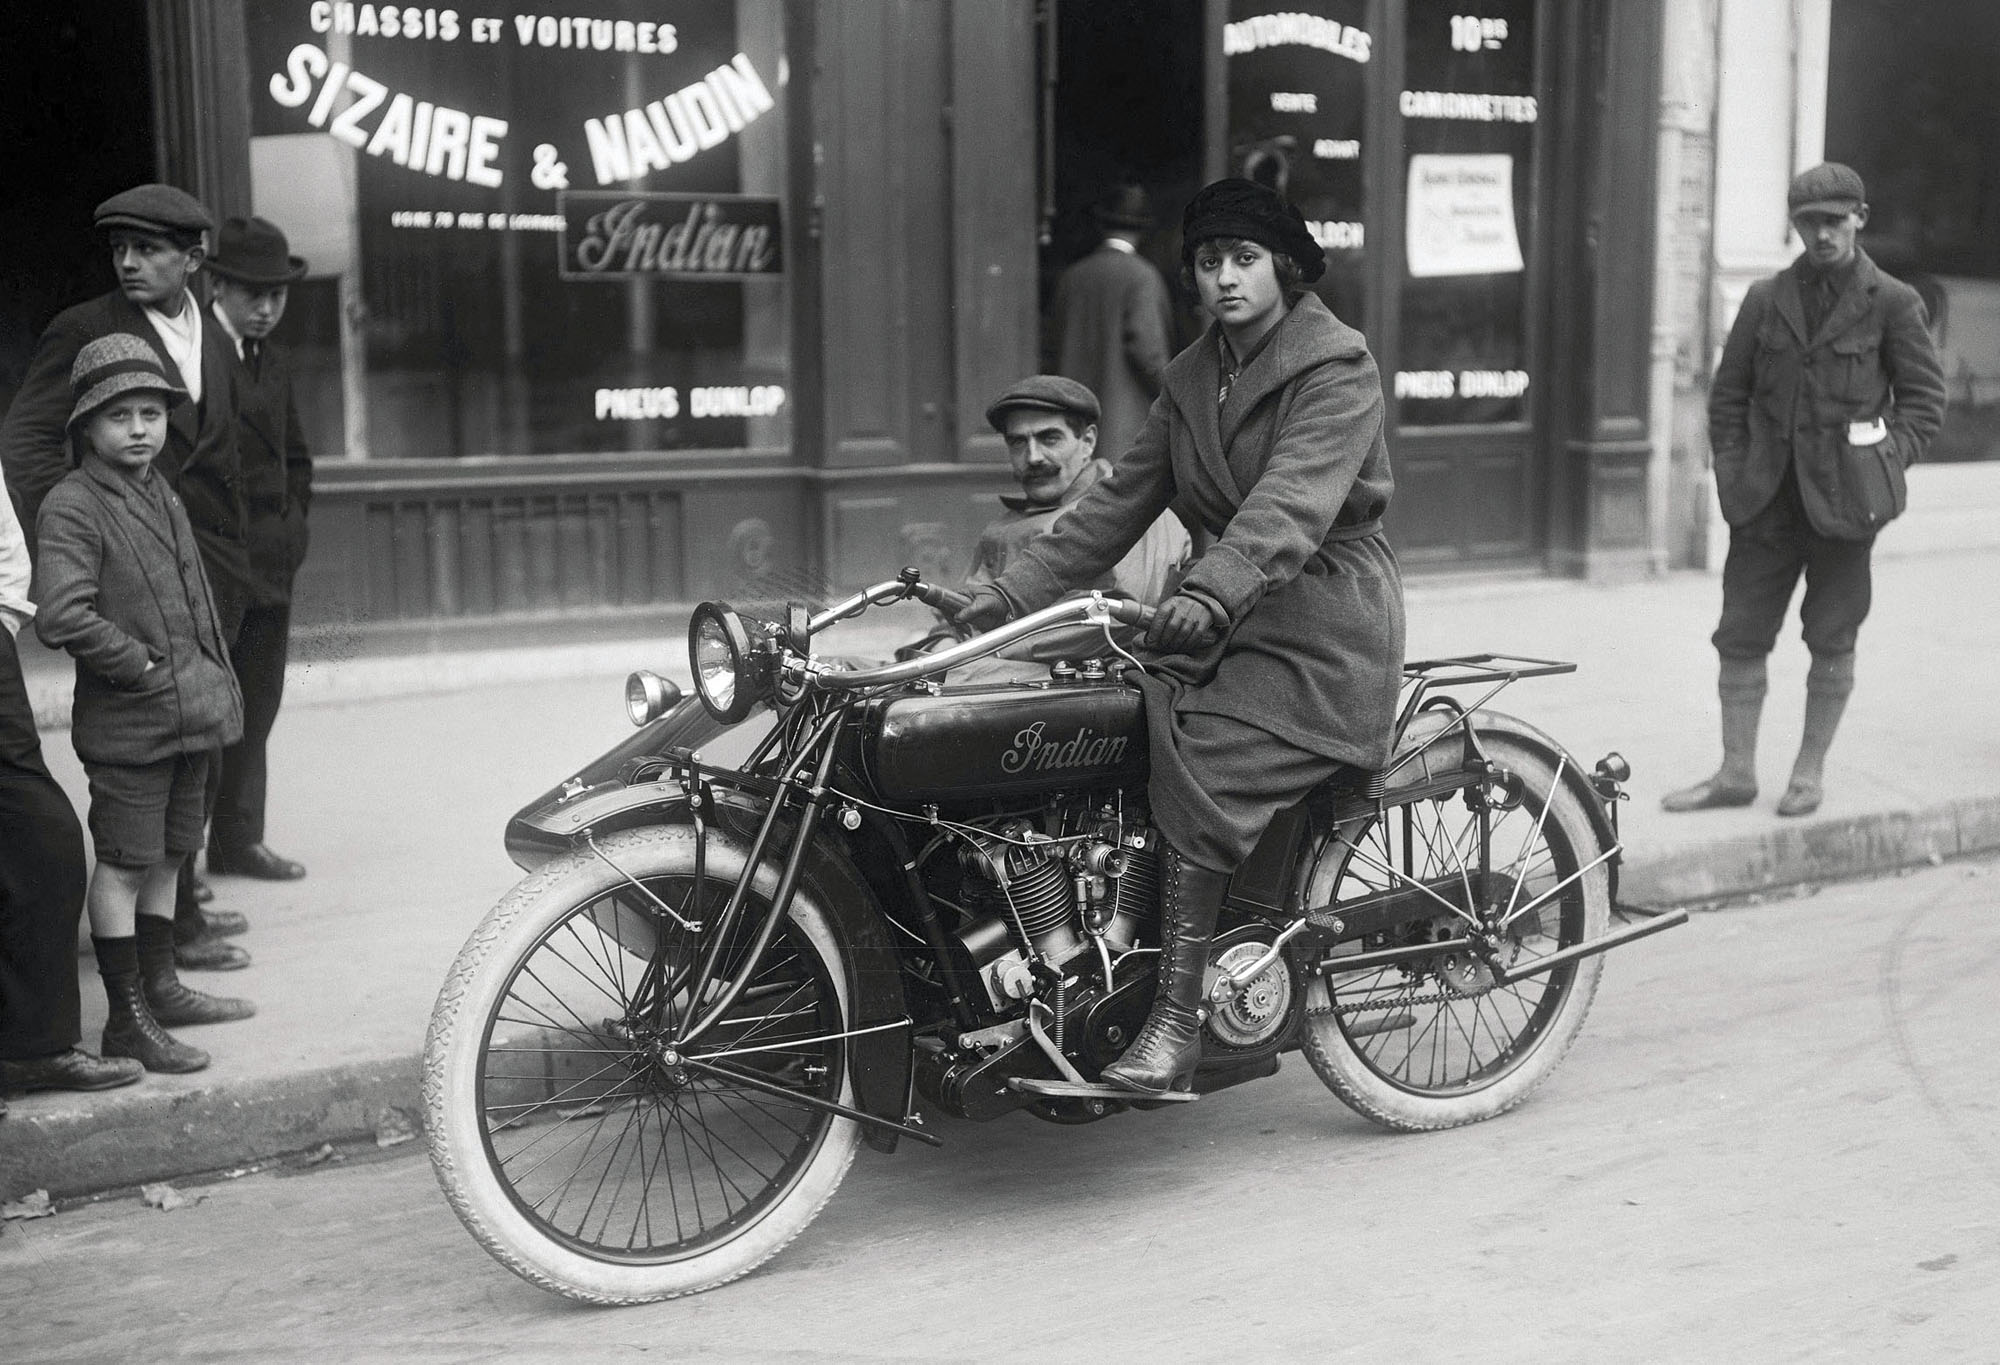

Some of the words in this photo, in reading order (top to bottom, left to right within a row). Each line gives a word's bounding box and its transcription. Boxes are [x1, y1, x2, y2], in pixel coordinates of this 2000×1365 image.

[310, 0, 460, 41] CHASSIS
[471, 17, 502, 43] ET
[514, 14, 678, 54] VOITURES
[269, 43, 508, 188] SIZAIRE
[531, 143, 570, 190] &
[585, 52, 775, 185] NAUDIN
[577, 200, 772, 272] Indian
[595, 386, 679, 420] PNEUS
[690, 385, 786, 418] DUNLOP
[1460, 370, 1530, 398] DUNLOP
[1001, 721, 1128, 774] Indian
